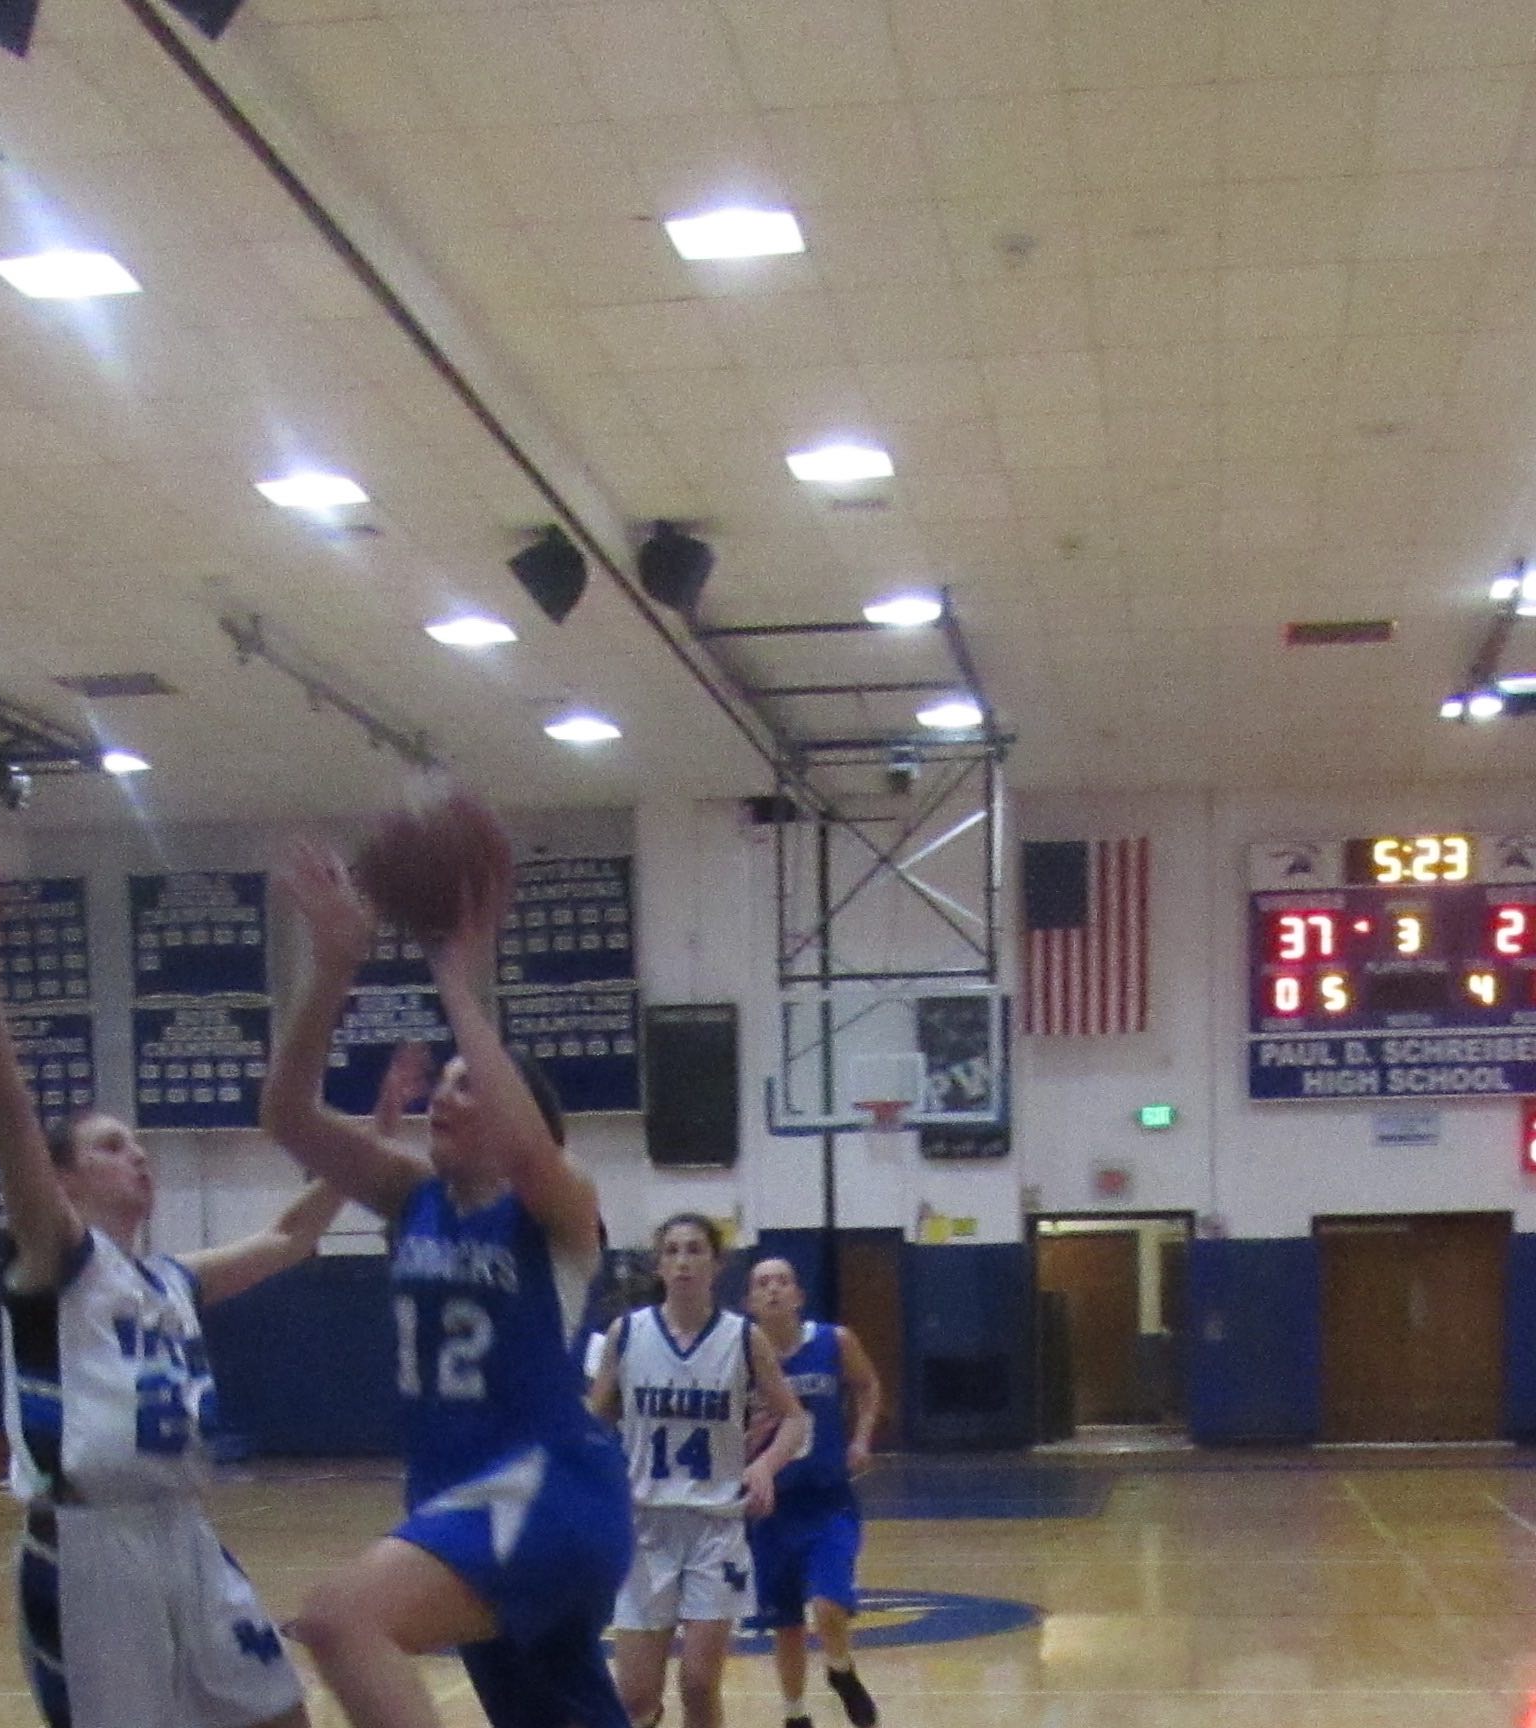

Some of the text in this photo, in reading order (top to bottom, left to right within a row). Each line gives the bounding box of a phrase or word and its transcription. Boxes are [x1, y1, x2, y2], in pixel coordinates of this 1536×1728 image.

[1372, 837, 1470, 883] 5:23
[141, 906, 258, 925] CHAMPIONS
[1279, 915, 1334, 960] 37
[1395, 916, 1422, 954] 3
[1274, 977, 1300, 1013] 0
[1320, 975, 1348, 1013] 5
[1468, 973, 1496, 1006] 4
[164, 1024, 243, 1043] SOCCER
[332, 1026, 452, 1045] CHAMPIONS
[509, 1013, 632, 1033] CHAMPIONS
[142, 1039, 263, 1057] CHAMPIONS
[1259, 1041, 1336, 1067] PAUL
[1343, 1039, 1373, 1065] D.
[1302, 1065, 1512, 1095] HIGH SCHOOL
[394, 1296, 494, 1399] 12
[634, 1384, 731, 1422] VIKINGS
[651, 1426, 712, 1480] 14
